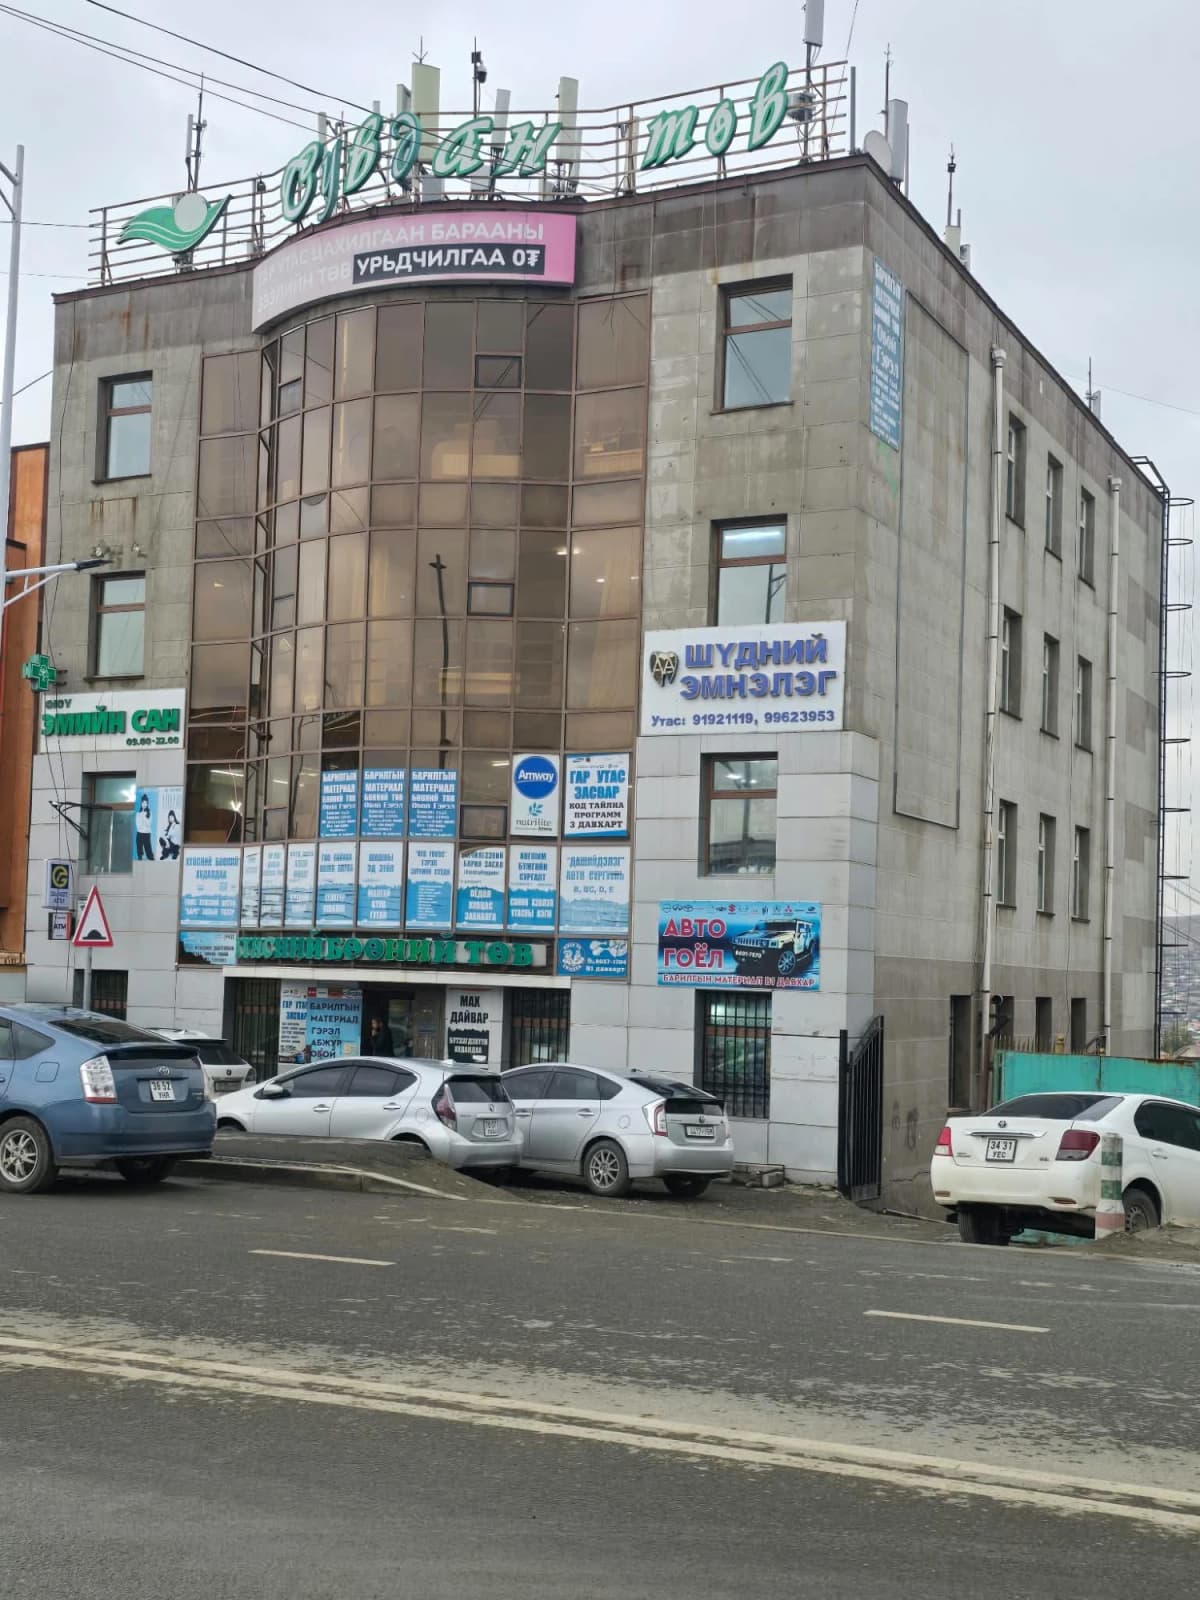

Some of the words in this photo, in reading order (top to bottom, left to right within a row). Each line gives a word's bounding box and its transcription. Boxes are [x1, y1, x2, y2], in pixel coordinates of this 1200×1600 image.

[313, 224, 424, 260] ЦАХИЛГААН
[431, 222, 544, 241] БАРААНЫ
[356, 248, 505, 276] УРЬДЧИЛГАА
[685, 633, 829, 671] ШҮДНИЙ
[680, 671, 838, 700] ЭМНЭЛЭГ
[41, 705, 127, 736] ЭМИЙН
[131, 708, 181, 733] САН
[651, 714, 685, 727] Утас:
[692, 712, 758, 727] 91921119,
[765, 710, 835, 725] 99623953
[518, 769, 554, 783] Amway
[570, 770, 590, 784] ГАР
[597, 769, 625, 783] УТАС
[575, 785, 619, 799] ЗАСВАР
[569, 802, 586, 810] КОД
[578, 821, 623, 829] ДАВХАРТ
[662, 918, 727, 939] АВТО
[464, 941, 534, 966] ТӨВ
[663, 943, 725, 969] ГОЁЛ
[663, 974, 712, 984] БАРИЛГЫН
[460, 995, 480, 1007] МАХ
[310, 1015, 359, 1024] МАТЕРИАЛ
[450, 1010, 489, 1024] ДАЙВАР
[311, 1027, 340, 1035] ГЭРЭЛ
[310, 1047, 336, 1058] ОБОЙ
